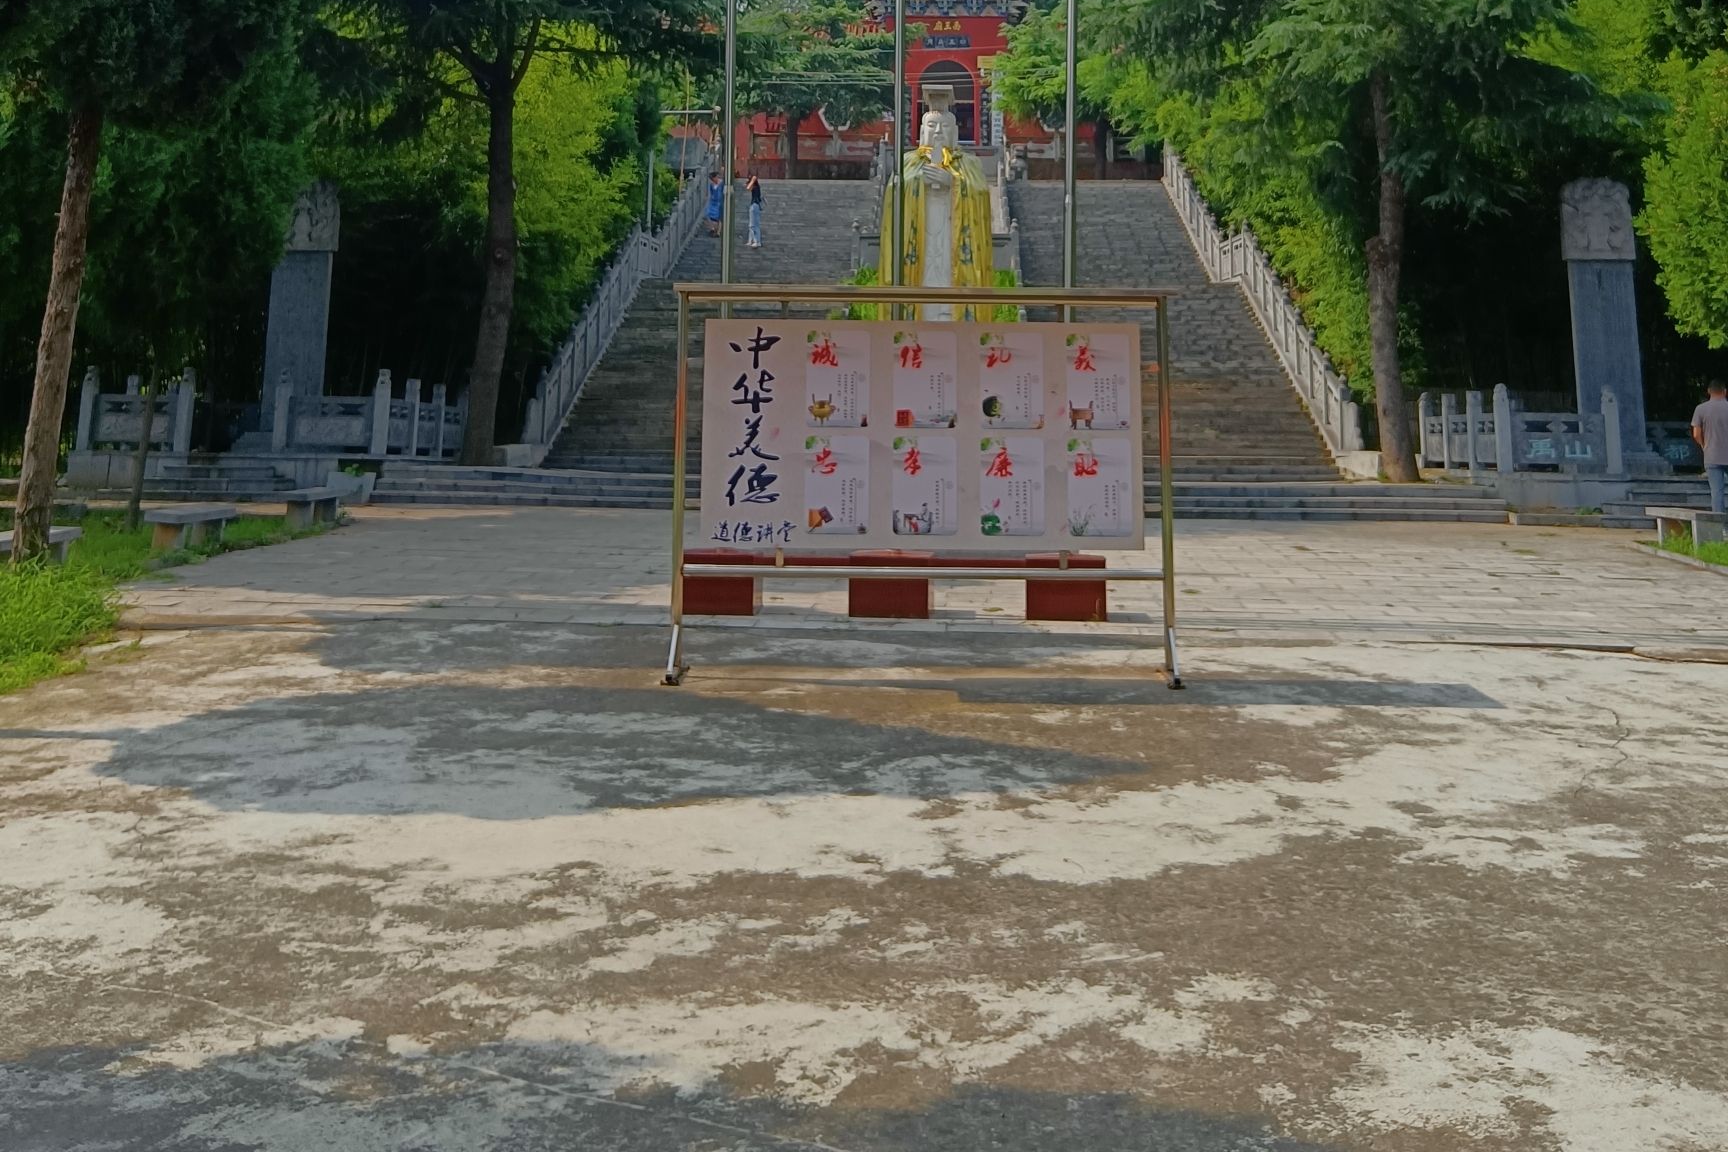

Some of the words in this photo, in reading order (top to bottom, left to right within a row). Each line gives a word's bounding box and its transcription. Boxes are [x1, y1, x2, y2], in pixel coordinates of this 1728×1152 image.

[899, 344, 922, 369] 信
[725, 326, 782, 507] 中华美德
[812, 447, 838, 474] 忠
[903, 447, 922, 475] 孝
[986, 447, 1014, 477] 廉
[1525, 438, 1592, 459] 禹山
[711, 519, 798, 544] 道德讲堂
